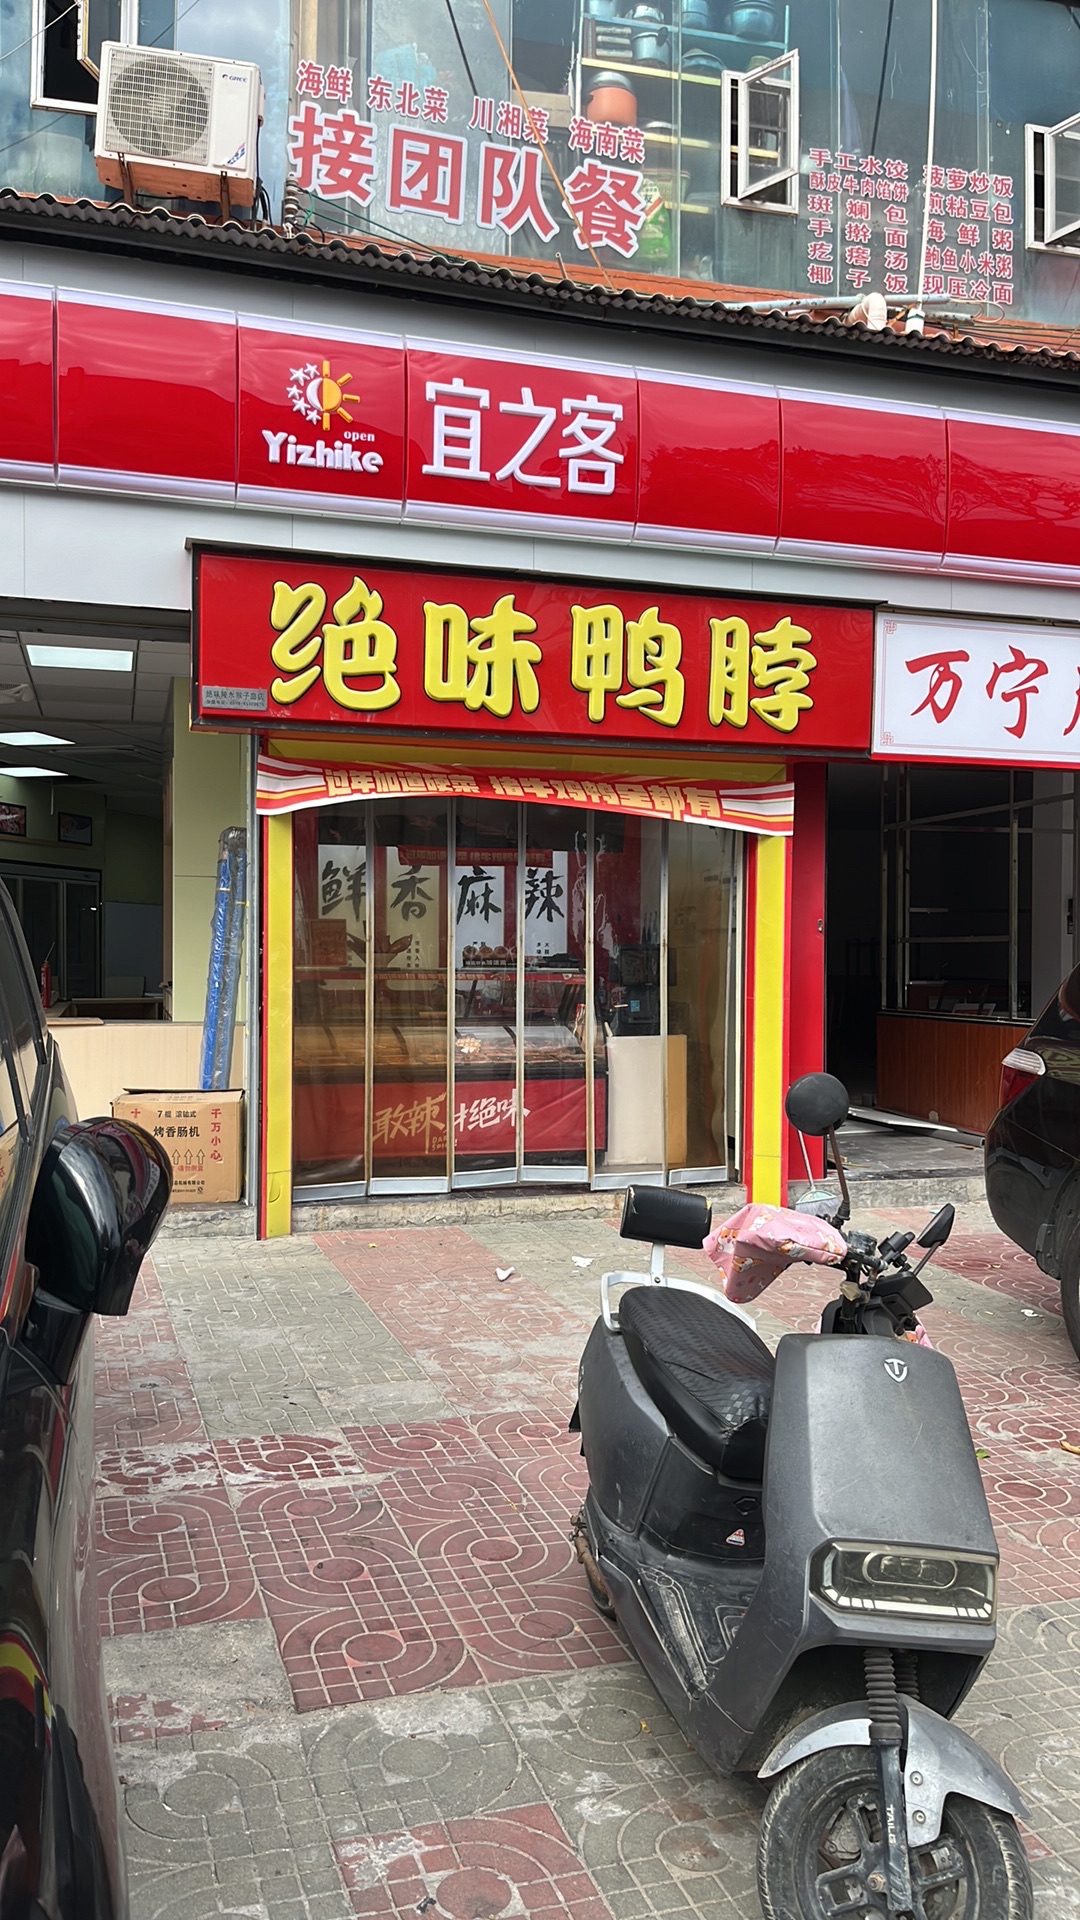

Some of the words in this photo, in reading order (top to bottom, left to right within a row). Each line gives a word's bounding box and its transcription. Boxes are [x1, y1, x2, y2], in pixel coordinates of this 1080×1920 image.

[297, 60, 353, 102] 海鲜
[367, 75, 450, 124] 东北菜
[469, 96, 550, 144] 川湘菜
[569, 115, 646, 165] 海南菜
[287, 101, 646, 259] 接团队餐
[808, 147, 908, 180] 手工水饺
[808, 170, 908, 203] 酥皮牛肉馅饼
[923, 165, 1014, 198] 菠萝炒饭
[923, 192, 1014, 224] 煎粘豆包
[807, 218, 908, 249] 手擀面
[807, 241, 908, 272] 疙瘩汤
[924, 245, 1013, 279] 鲍鱼小米粥
[807, 264, 908, 294] 椰子饭
[923, 275, 1014, 305] 现压冷面
[261, 429, 384, 474] Yizhike
[343, 430, 375, 442] open
[421, 377, 625, 495] 宜之客
[268, 575, 818, 735] 绝味鸭脖
[905, 645, 1080, 739] 万宁
[324, 769, 480, 796] 过年加道硬菜
[488, 775, 722, 821] 猪牛鸡鸭全都有
[153, 1126, 200, 1137] 烤香肠机
[211, 1108, 222, 1161] 千万小心
